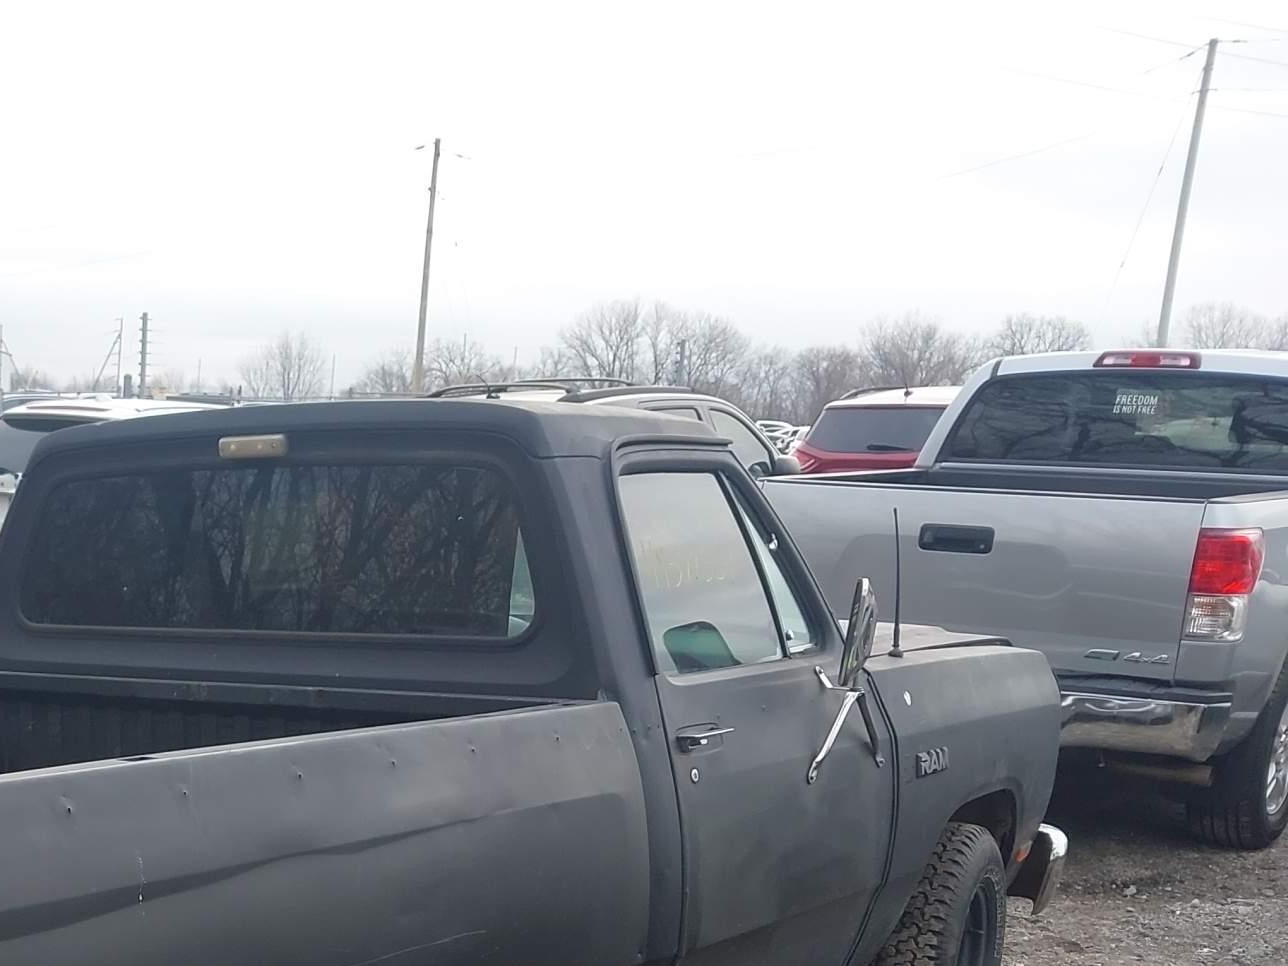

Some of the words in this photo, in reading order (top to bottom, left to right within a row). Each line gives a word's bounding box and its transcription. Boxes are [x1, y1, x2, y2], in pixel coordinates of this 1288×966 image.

[1115, 394, 1158, 405] FREEDOM
[1113, 405, 1121, 414] IS
[1122, 405, 1136, 414] NOT
[1137, 406, 1156, 415] FREE
[916, 746, 950, 779] RAM
